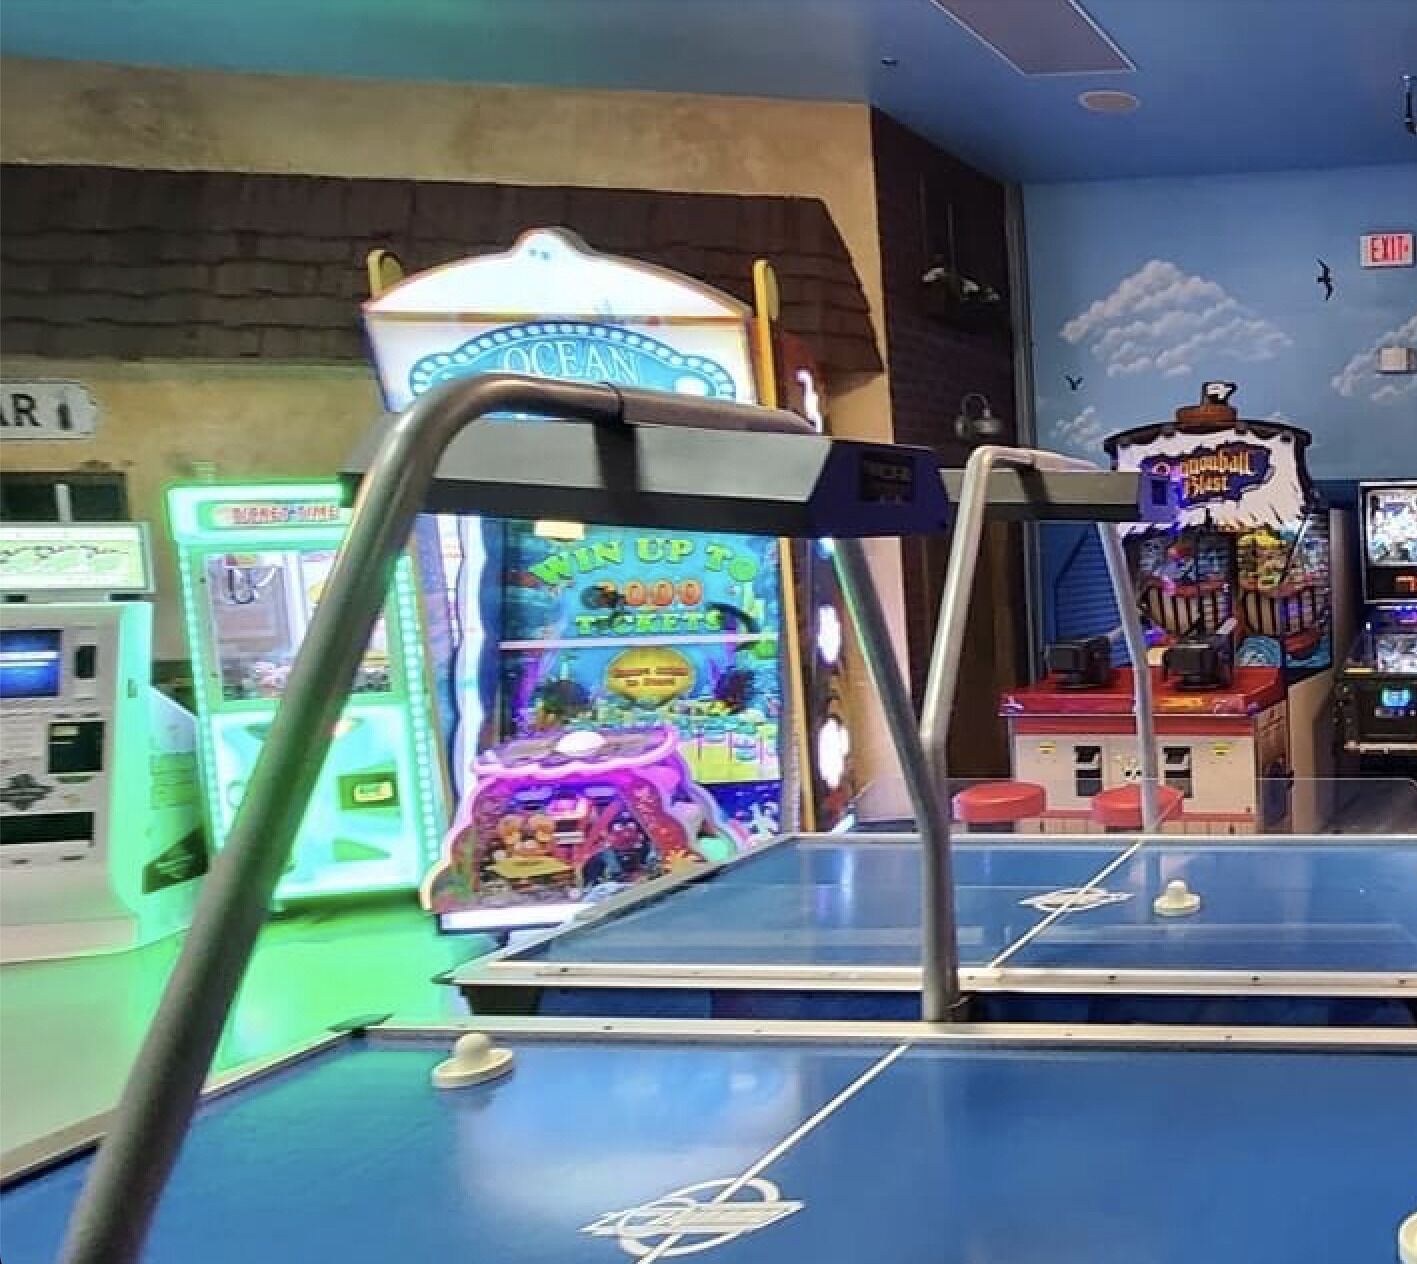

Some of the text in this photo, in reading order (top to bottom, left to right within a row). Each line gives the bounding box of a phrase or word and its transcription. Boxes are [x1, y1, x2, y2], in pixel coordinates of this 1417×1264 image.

[1371, 235, 1403, 262] EXIT
[503, 340, 641, 385] OCEAN
[527, 537, 759, 585] WIN UP TO
